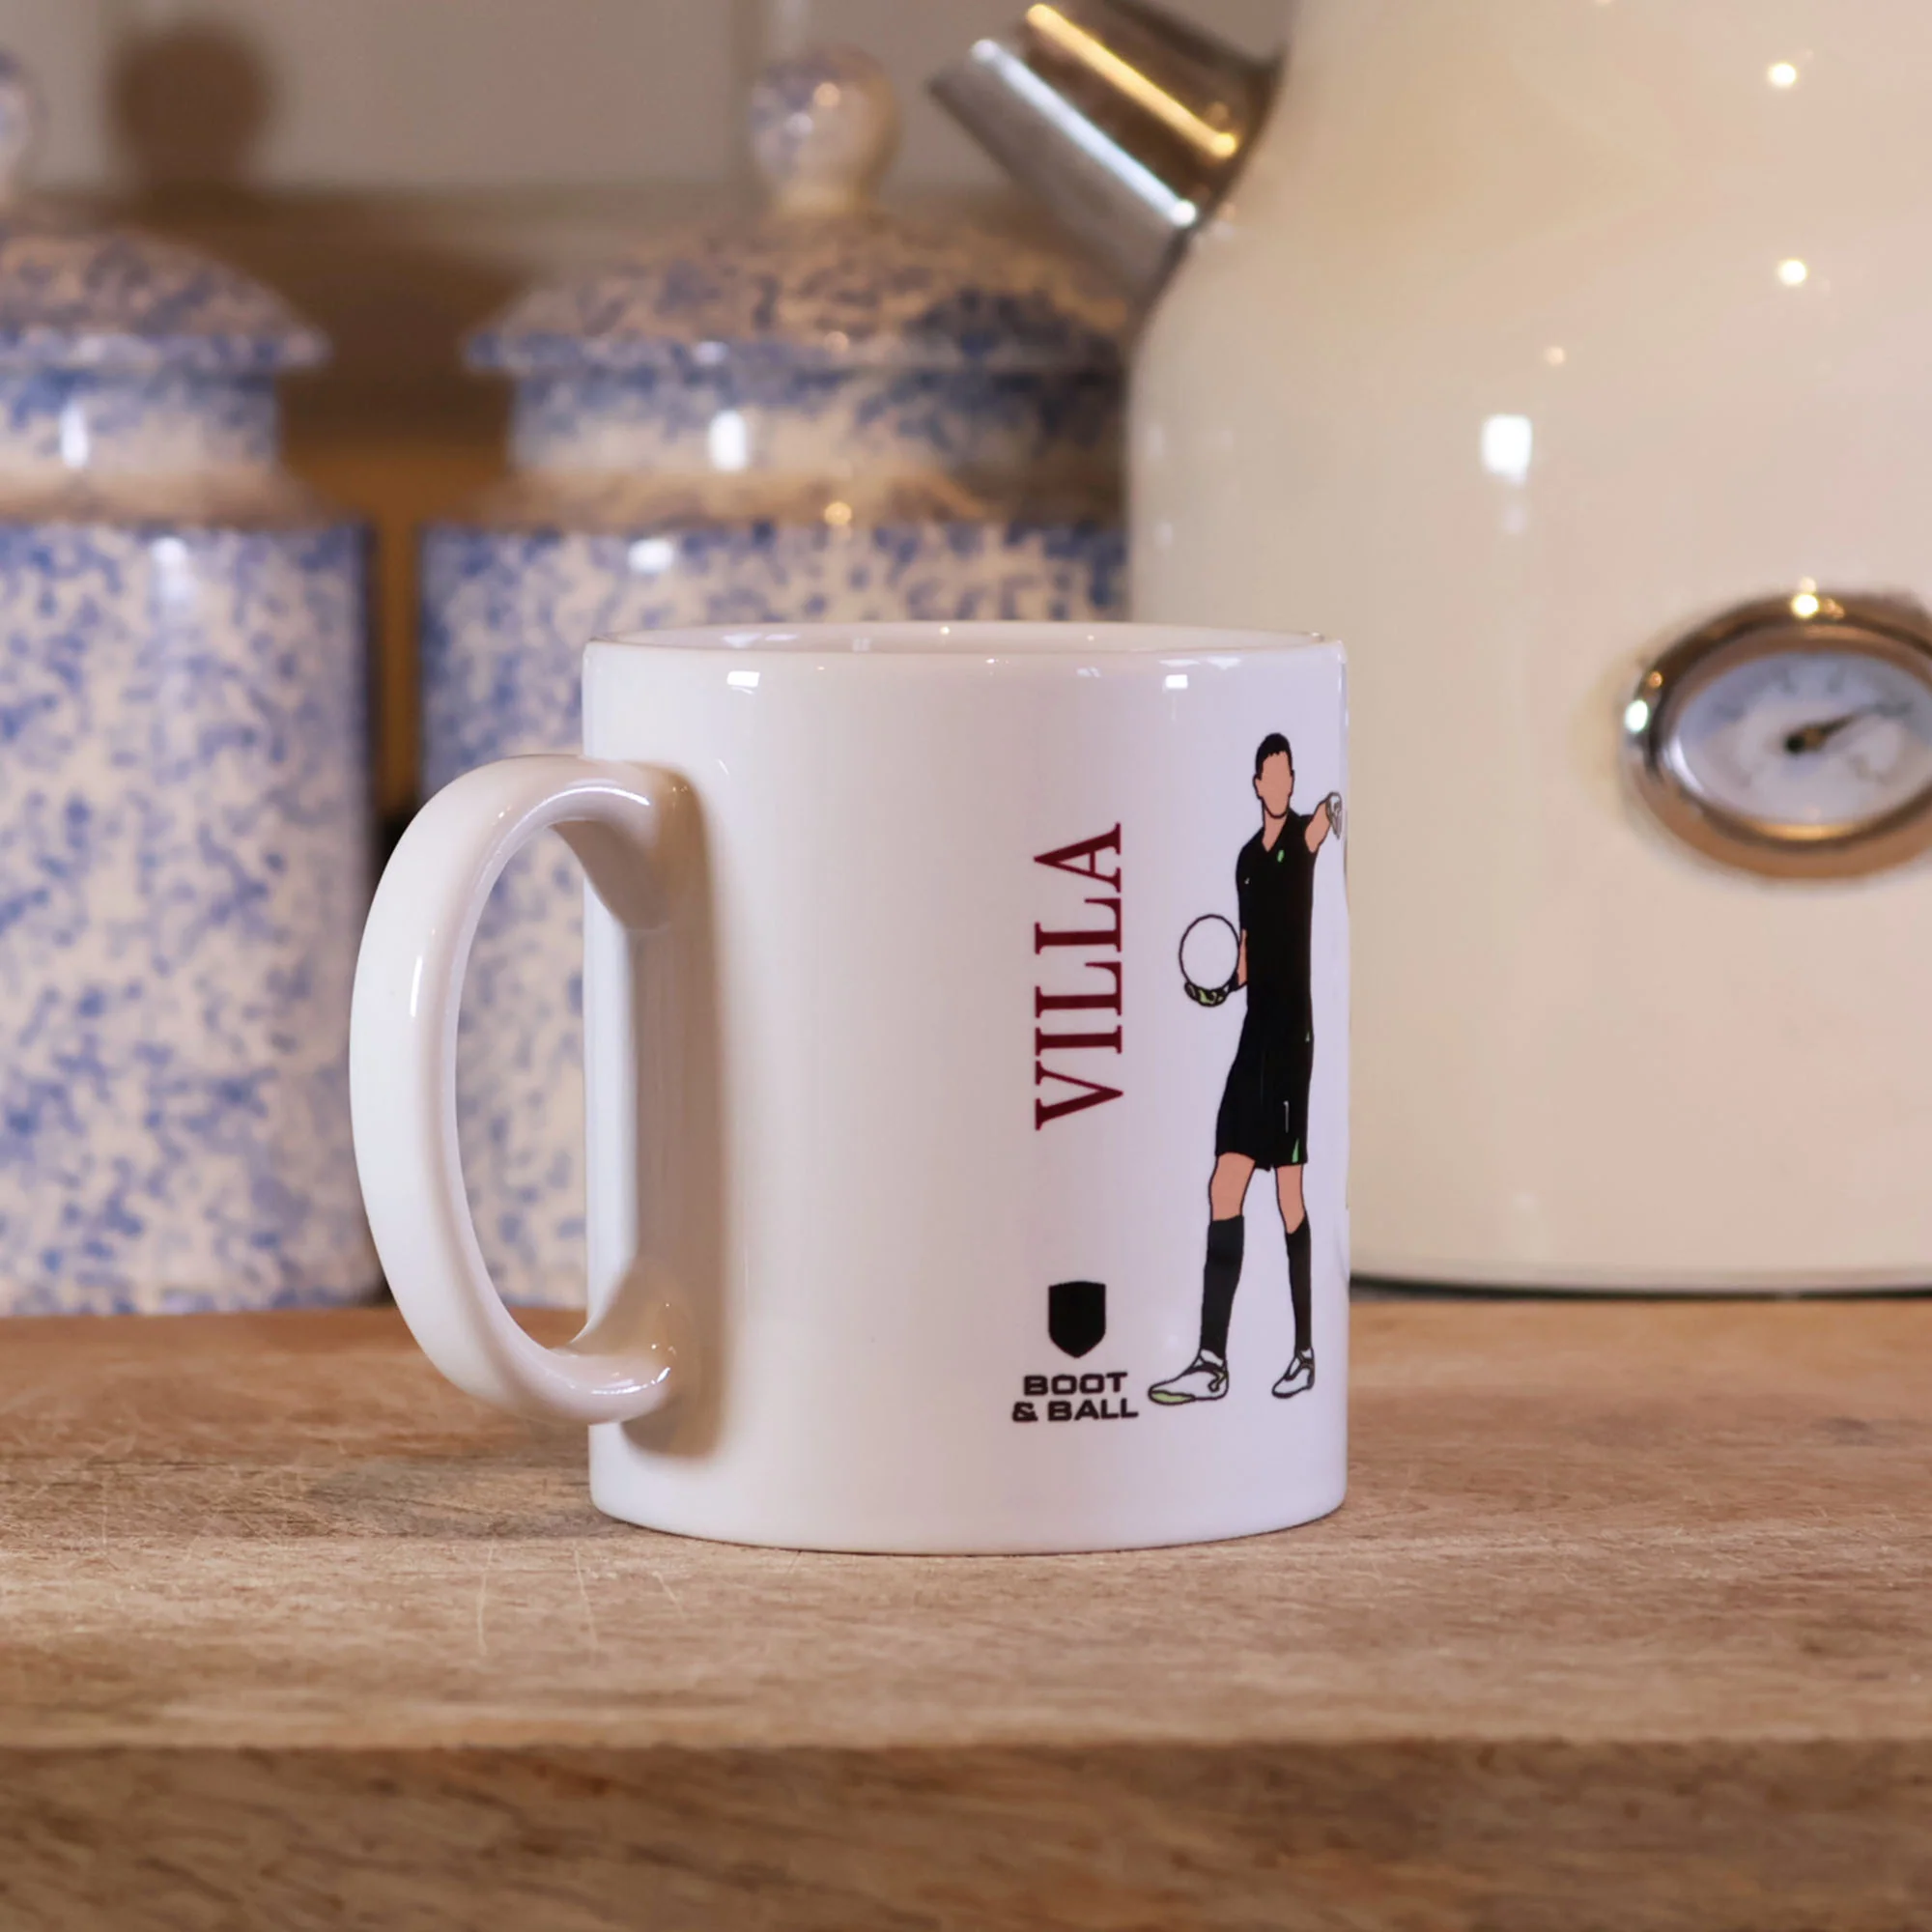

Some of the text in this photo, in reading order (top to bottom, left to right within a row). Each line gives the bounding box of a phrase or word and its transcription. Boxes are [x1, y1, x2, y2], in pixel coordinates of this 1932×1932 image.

[1034, 822, 1123, 1130] VILLA
[1023, 1371, 1127, 1396] BOOT
[1011, 1398, 1139, 1423] & BALL
